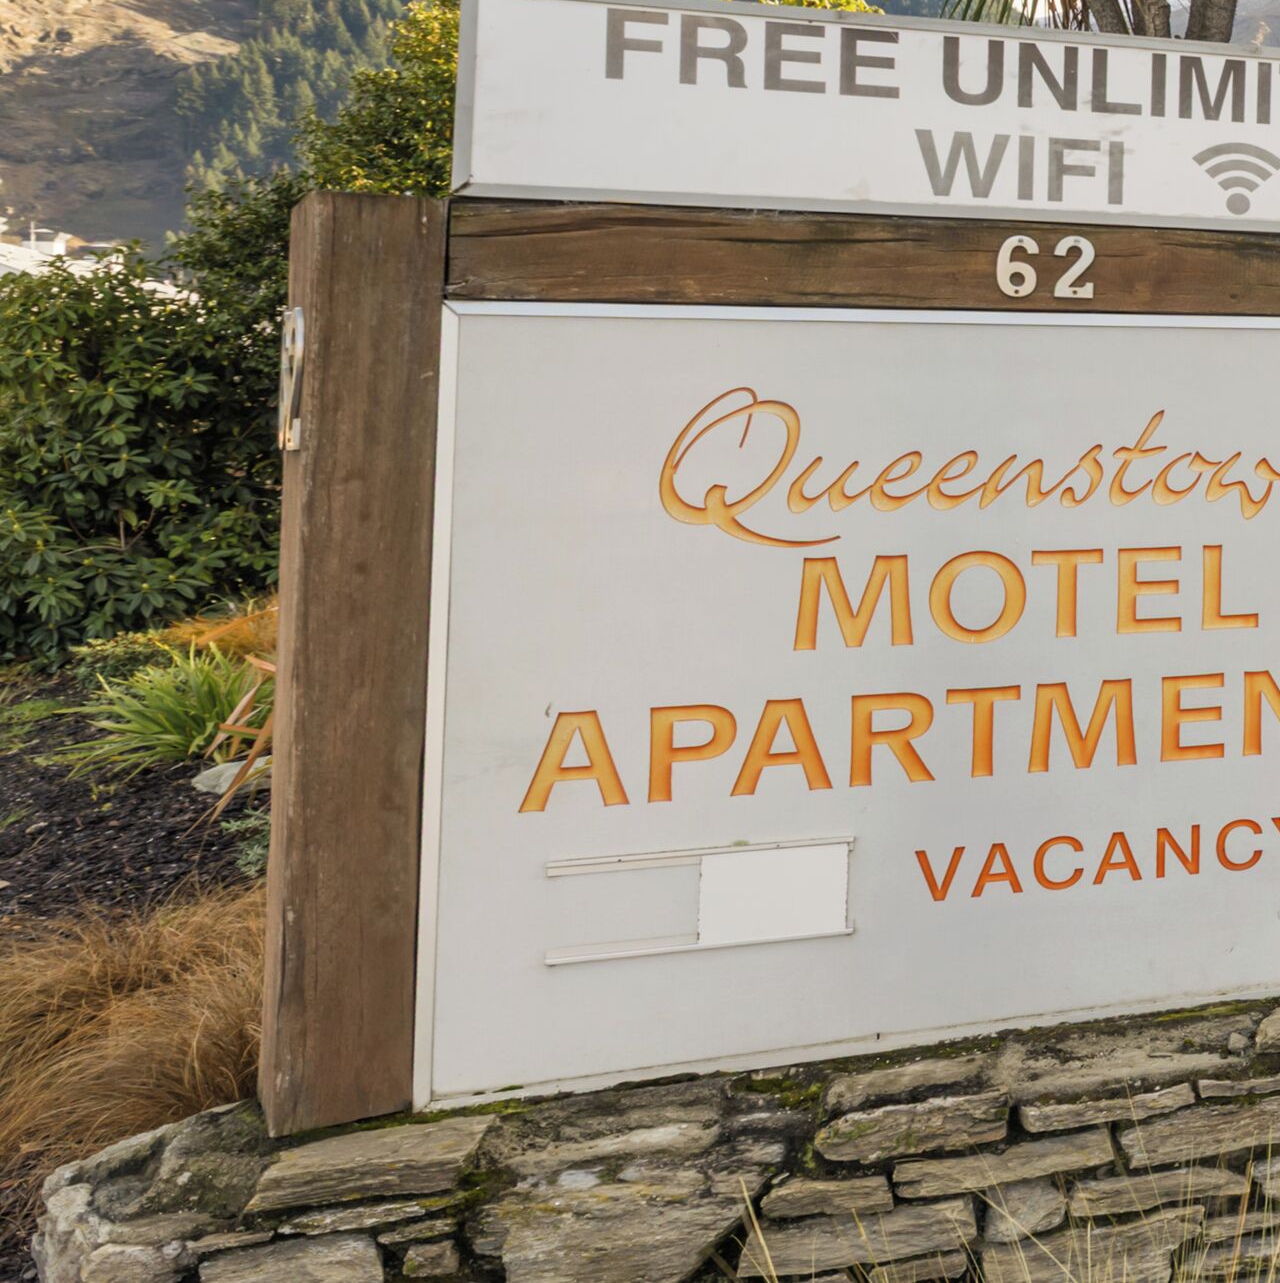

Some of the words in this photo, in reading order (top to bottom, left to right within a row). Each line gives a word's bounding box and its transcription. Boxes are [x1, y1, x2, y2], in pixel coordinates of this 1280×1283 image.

[605, 7, 900, 99] FREE
[914, 129, 1125, 205] WIFI
[996, 235, 1096, 299] 62
[792, 544, 1260, 652] MOTEL
